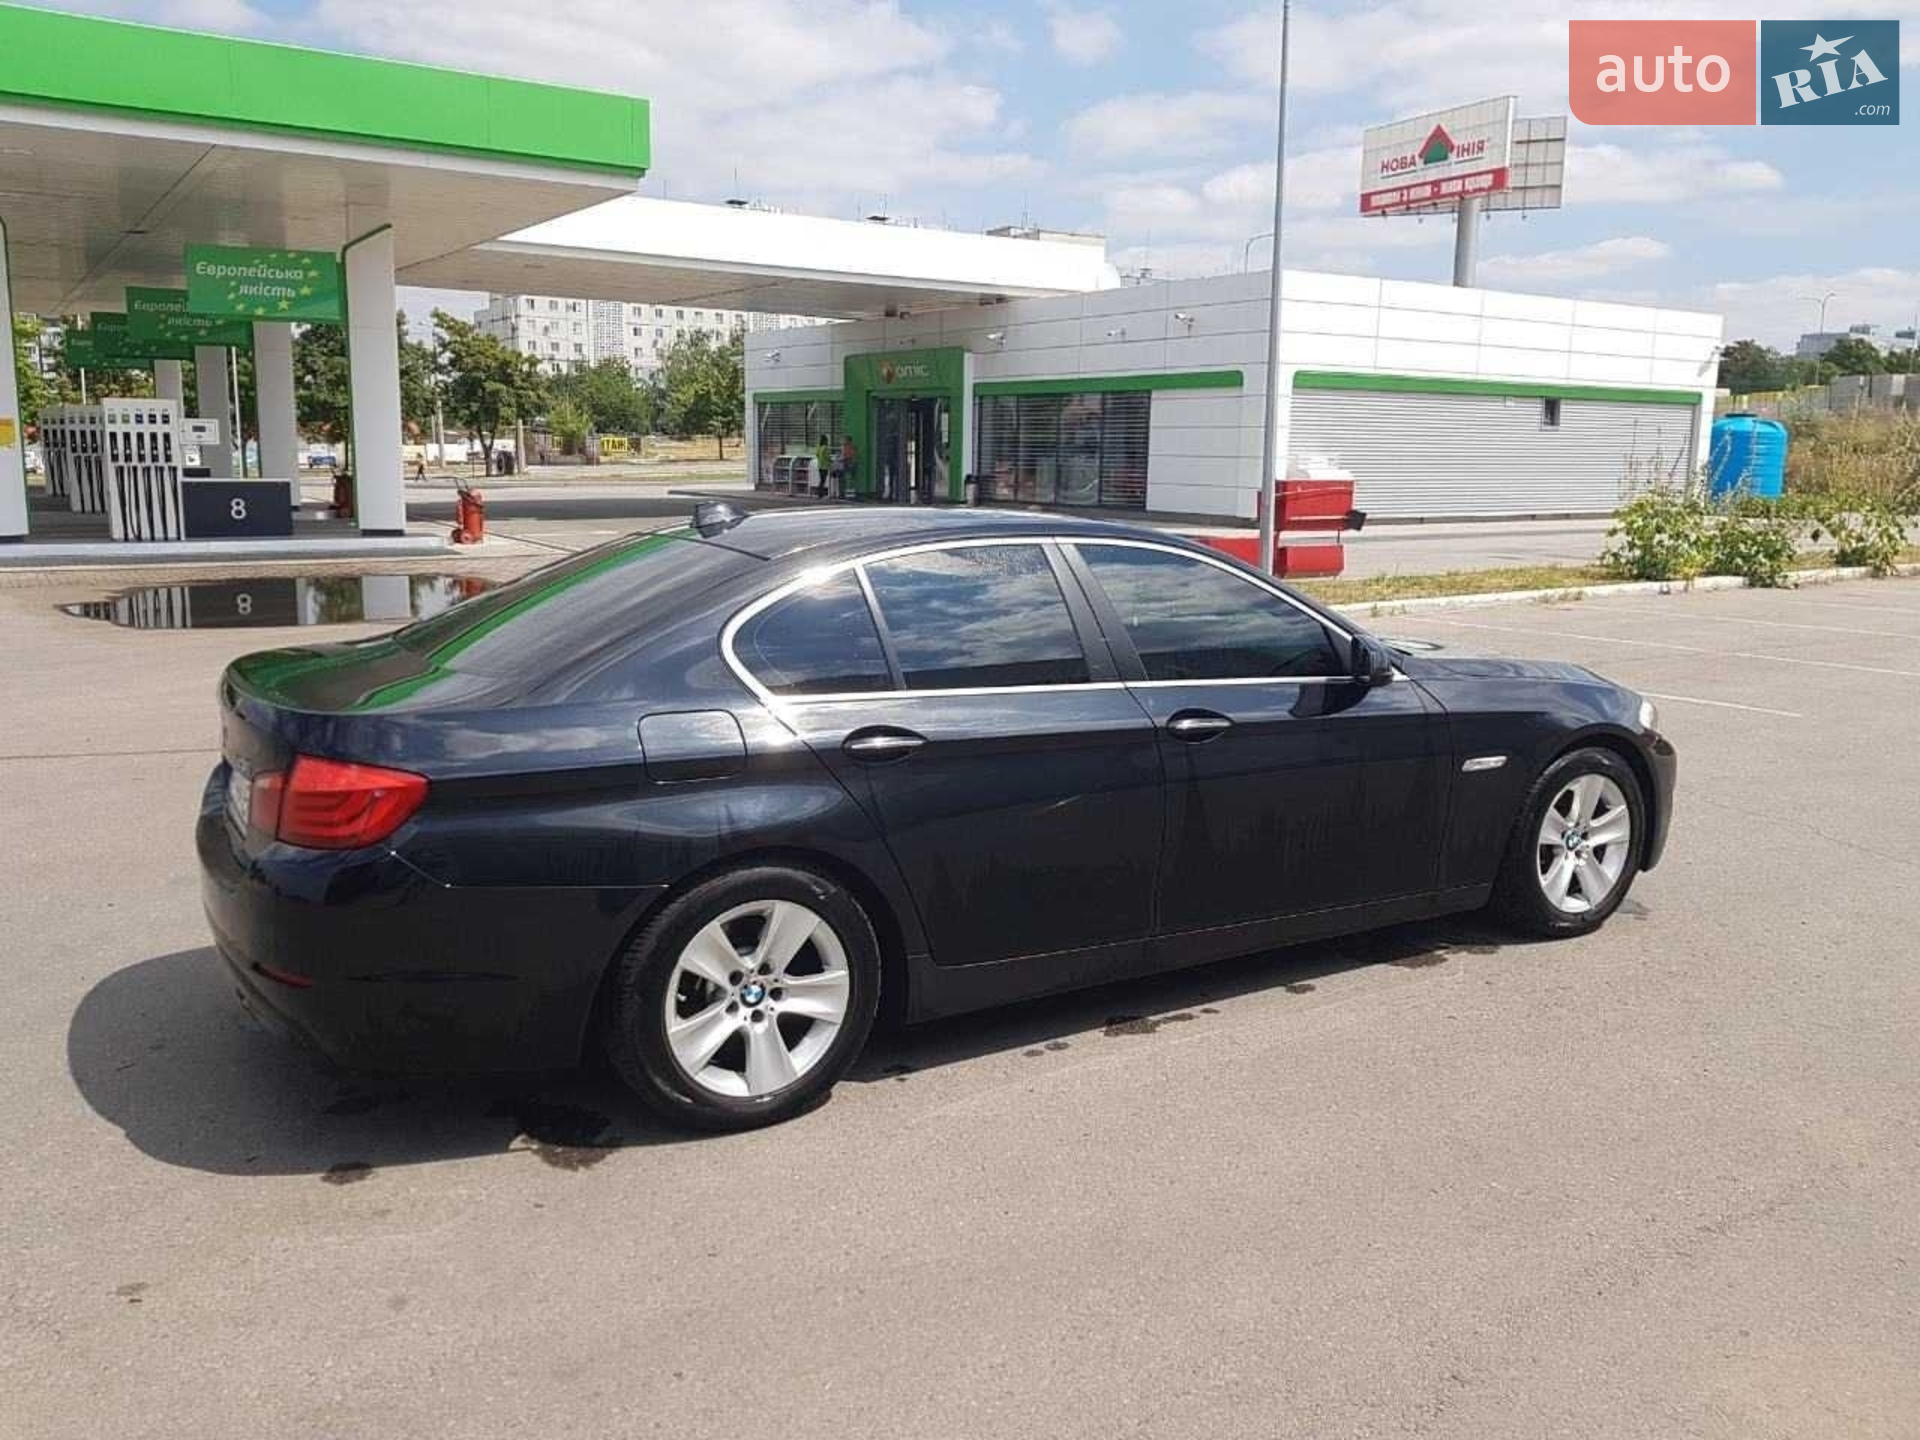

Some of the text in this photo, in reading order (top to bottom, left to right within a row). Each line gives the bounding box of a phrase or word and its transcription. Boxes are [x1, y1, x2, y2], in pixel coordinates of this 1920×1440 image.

[1380, 154, 1417, 174] НОВА
[195, 261, 304, 280] Європейська
[239, 282, 296, 298] якість
[230, 498, 247, 519] 8
